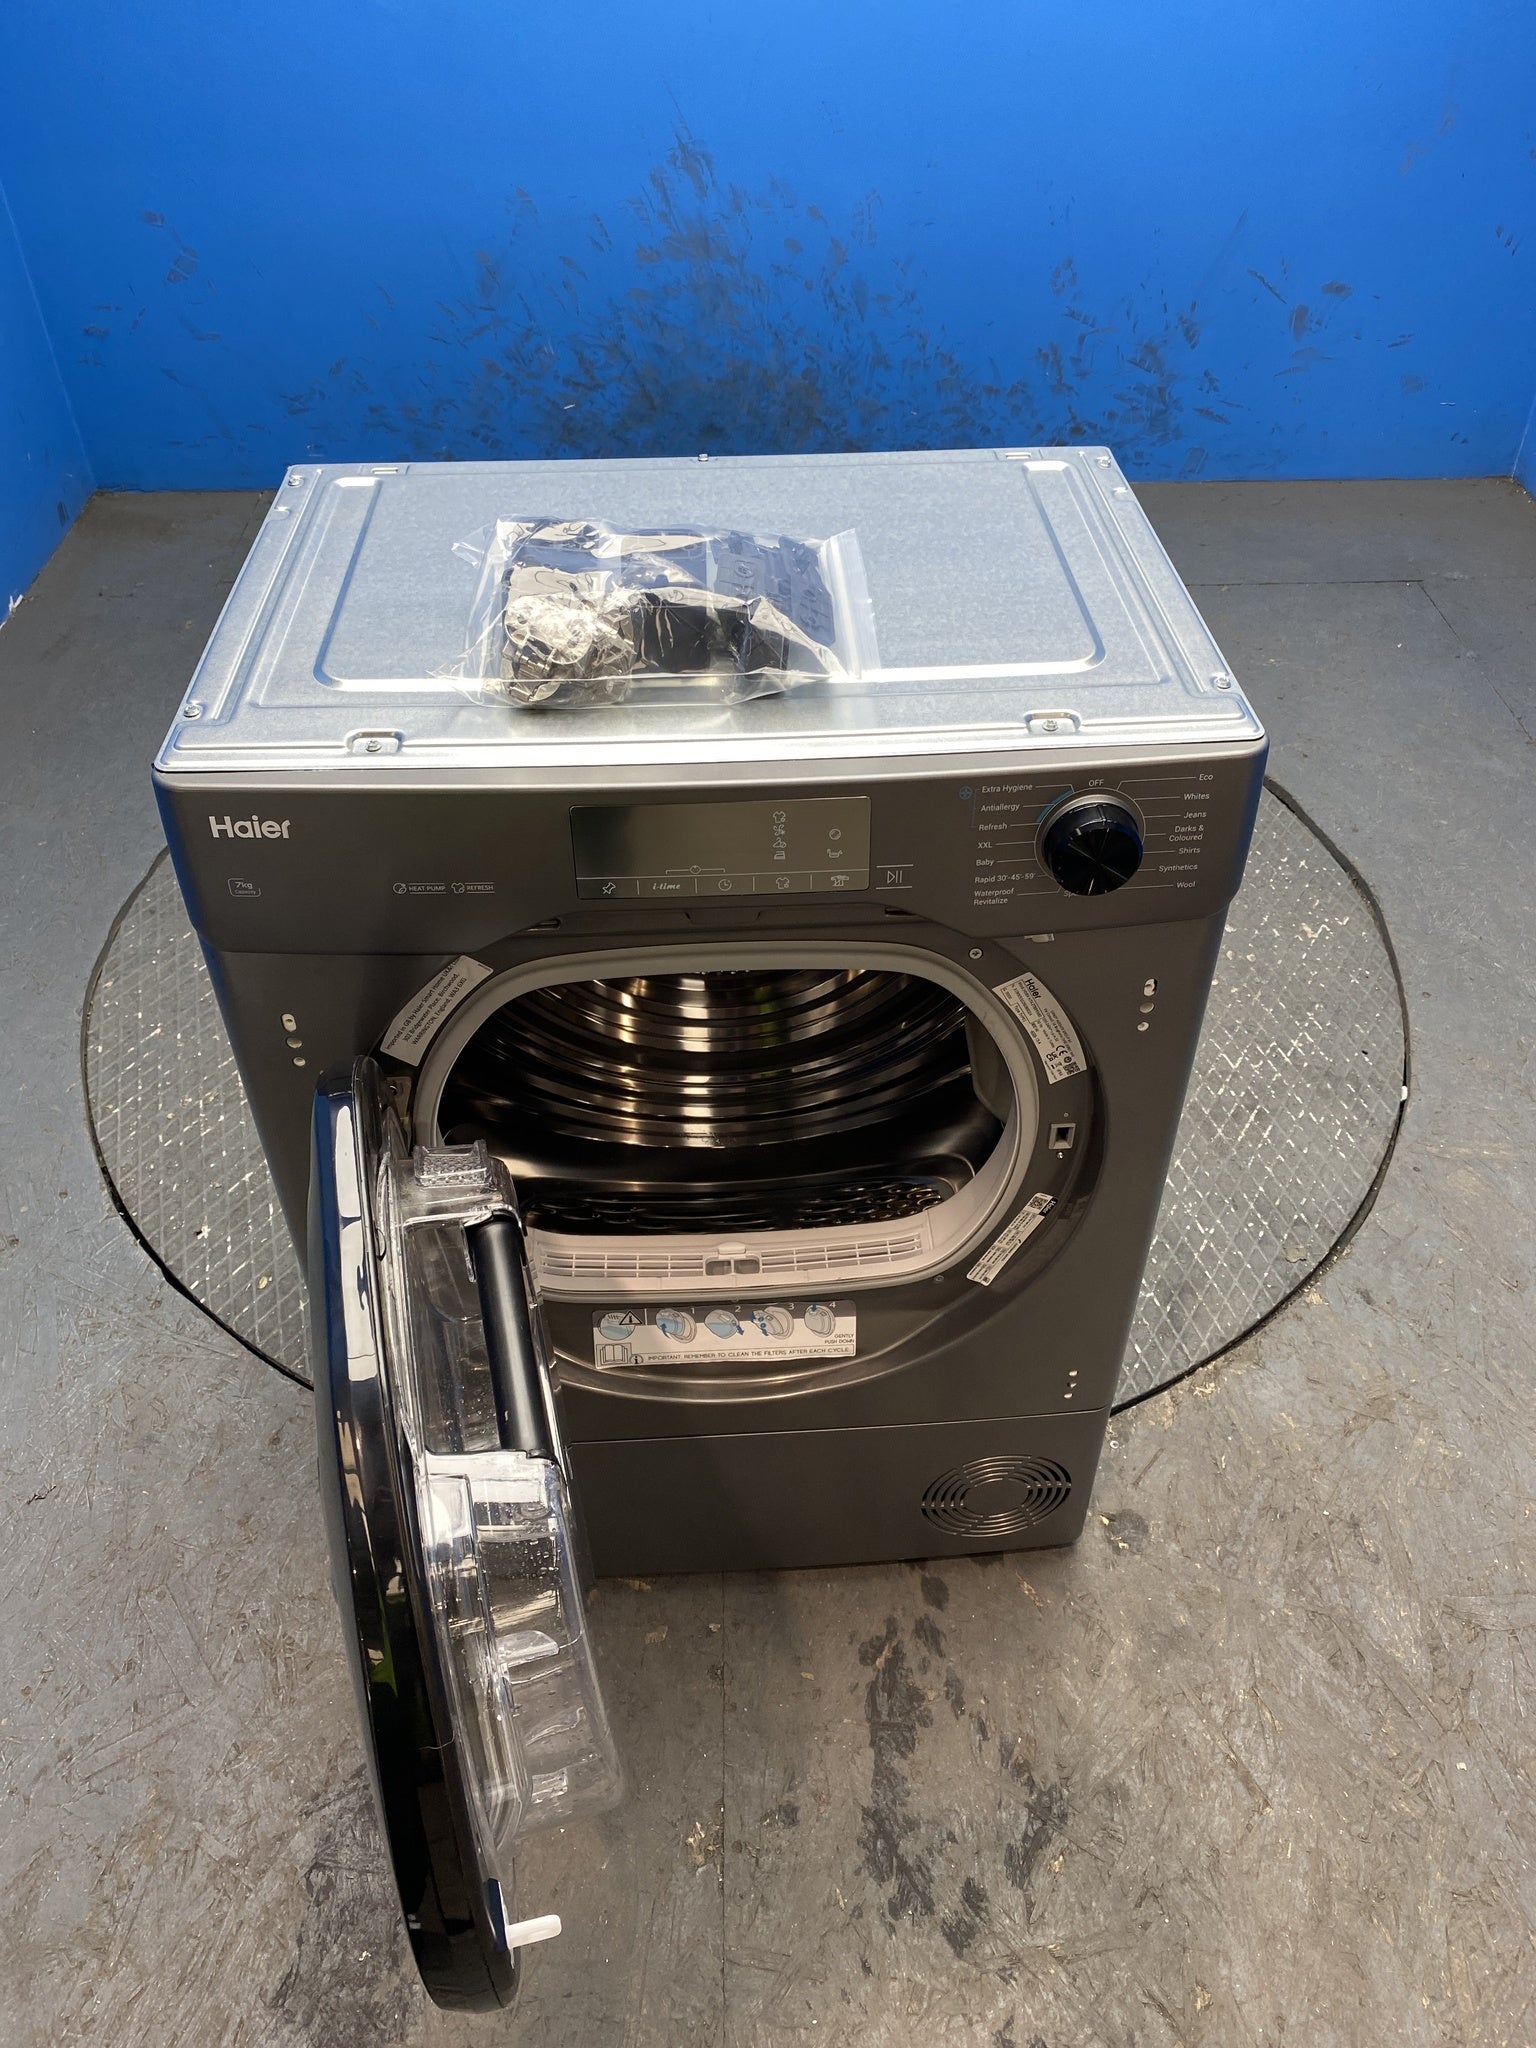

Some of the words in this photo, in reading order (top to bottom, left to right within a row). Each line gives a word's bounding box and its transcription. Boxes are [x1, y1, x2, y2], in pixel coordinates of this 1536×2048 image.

[1088, 779, 1104, 787] OFF
[982, 785, 1001, 793] Extra
[1002, 783, 1033, 793] Hygiene
[1184, 793, 1210, 801] Whites
[980, 803, 1020, 812] Antiallergy
[1184, 811, 1207, 819] Jeans
[208, 815, 292, 839] Haier
[979, 823, 1007, 831] Refresh
[1175, 825, 1197, 833] Darks
[1169, 833, 1203, 842] Coloured
[1179, 846, 1201, 855] Shirts
[976, 858, 994, 867] Baby
[1158, 863, 1198, 872] Synthetics
[975, 875, 996, 884] Rapid
[235, 881, 253, 890] 7kg
[427, 884, 446, 892] PUMP
[652, 881, 681, 892] i-time
[1177, 881, 1196, 889] Wool
[974, 888, 1015, 897] Waterproof
[973, 897, 1008, 906] Revitalize
[1025, 978, 1041, 999] Haier
[422, 990, 434, 1003] Smart
[1042, 1201, 1056, 1213] Haier
[735, 1305, 742, 1313] 2
